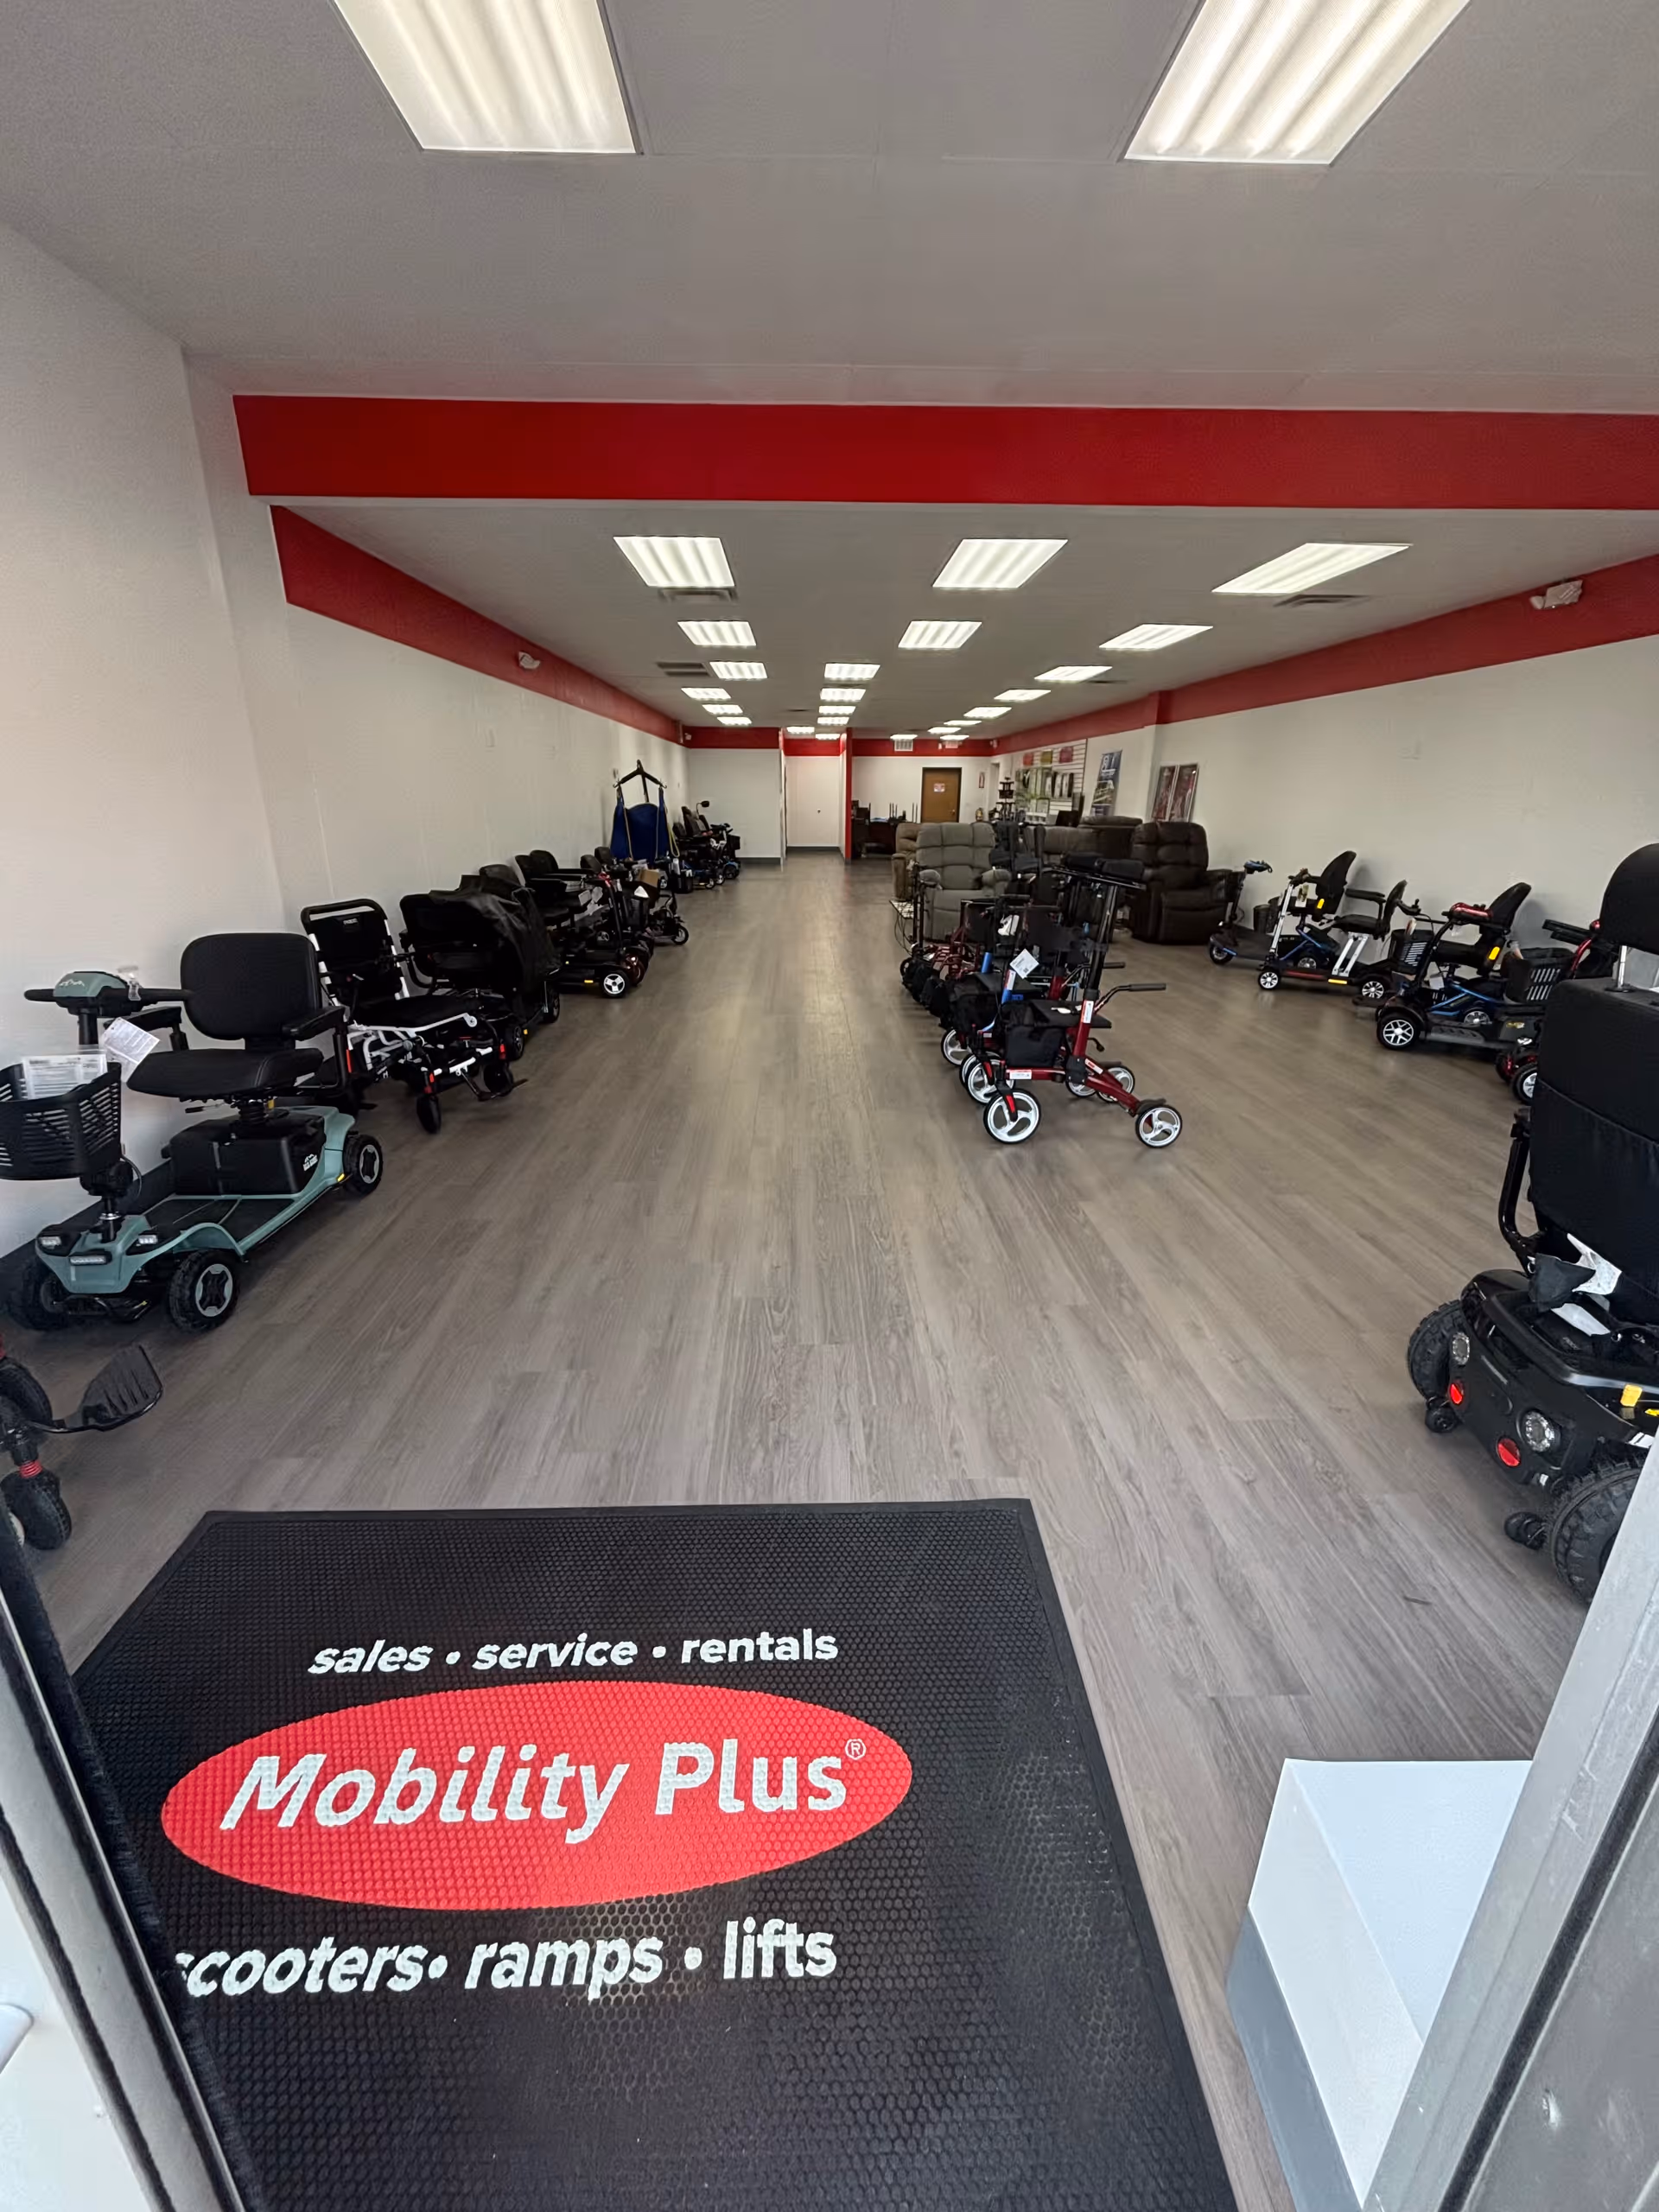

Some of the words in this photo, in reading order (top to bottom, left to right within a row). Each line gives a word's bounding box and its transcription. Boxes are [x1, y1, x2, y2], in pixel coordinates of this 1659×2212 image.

[307, 1639, 434, 1675] sales
[472, 1632, 639, 1670] service
[681, 1628, 839, 1664] rentals
[219, 1744, 630, 1845] Mobility
[464, 1936, 664, 2003] ramps
[723, 1916, 837, 1980] lifts
